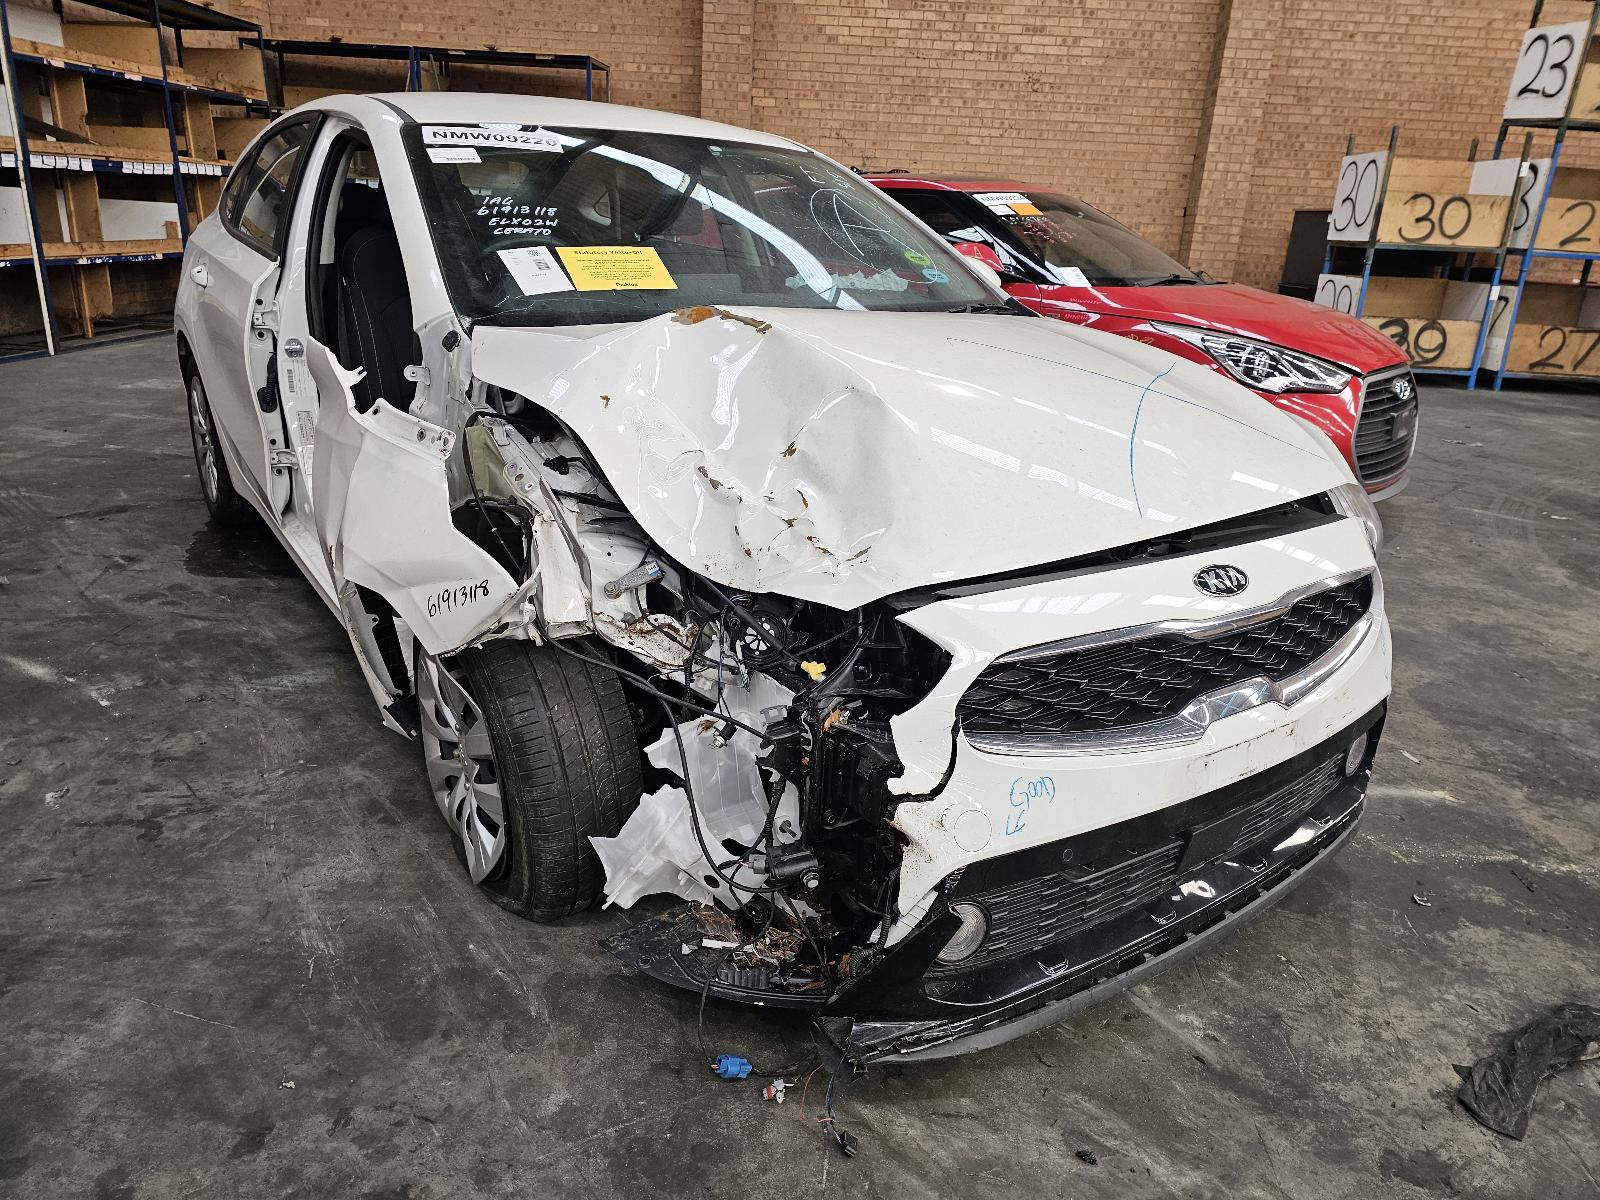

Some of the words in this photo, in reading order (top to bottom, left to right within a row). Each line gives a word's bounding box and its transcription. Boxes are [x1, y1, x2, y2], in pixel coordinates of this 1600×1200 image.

[1517, 33, 1575, 97] 23
[432, 131, 557, 146] NMW09220
[1334, 159, 1378, 232] 30
[1398, 192, 1472, 242] 30
[1559, 201, 1600, 247] 2
[1529, 326, 1600, 371] 27
[1200, 567, 1246, 592] KIA
[1009, 776, 1056, 810] GOOD
